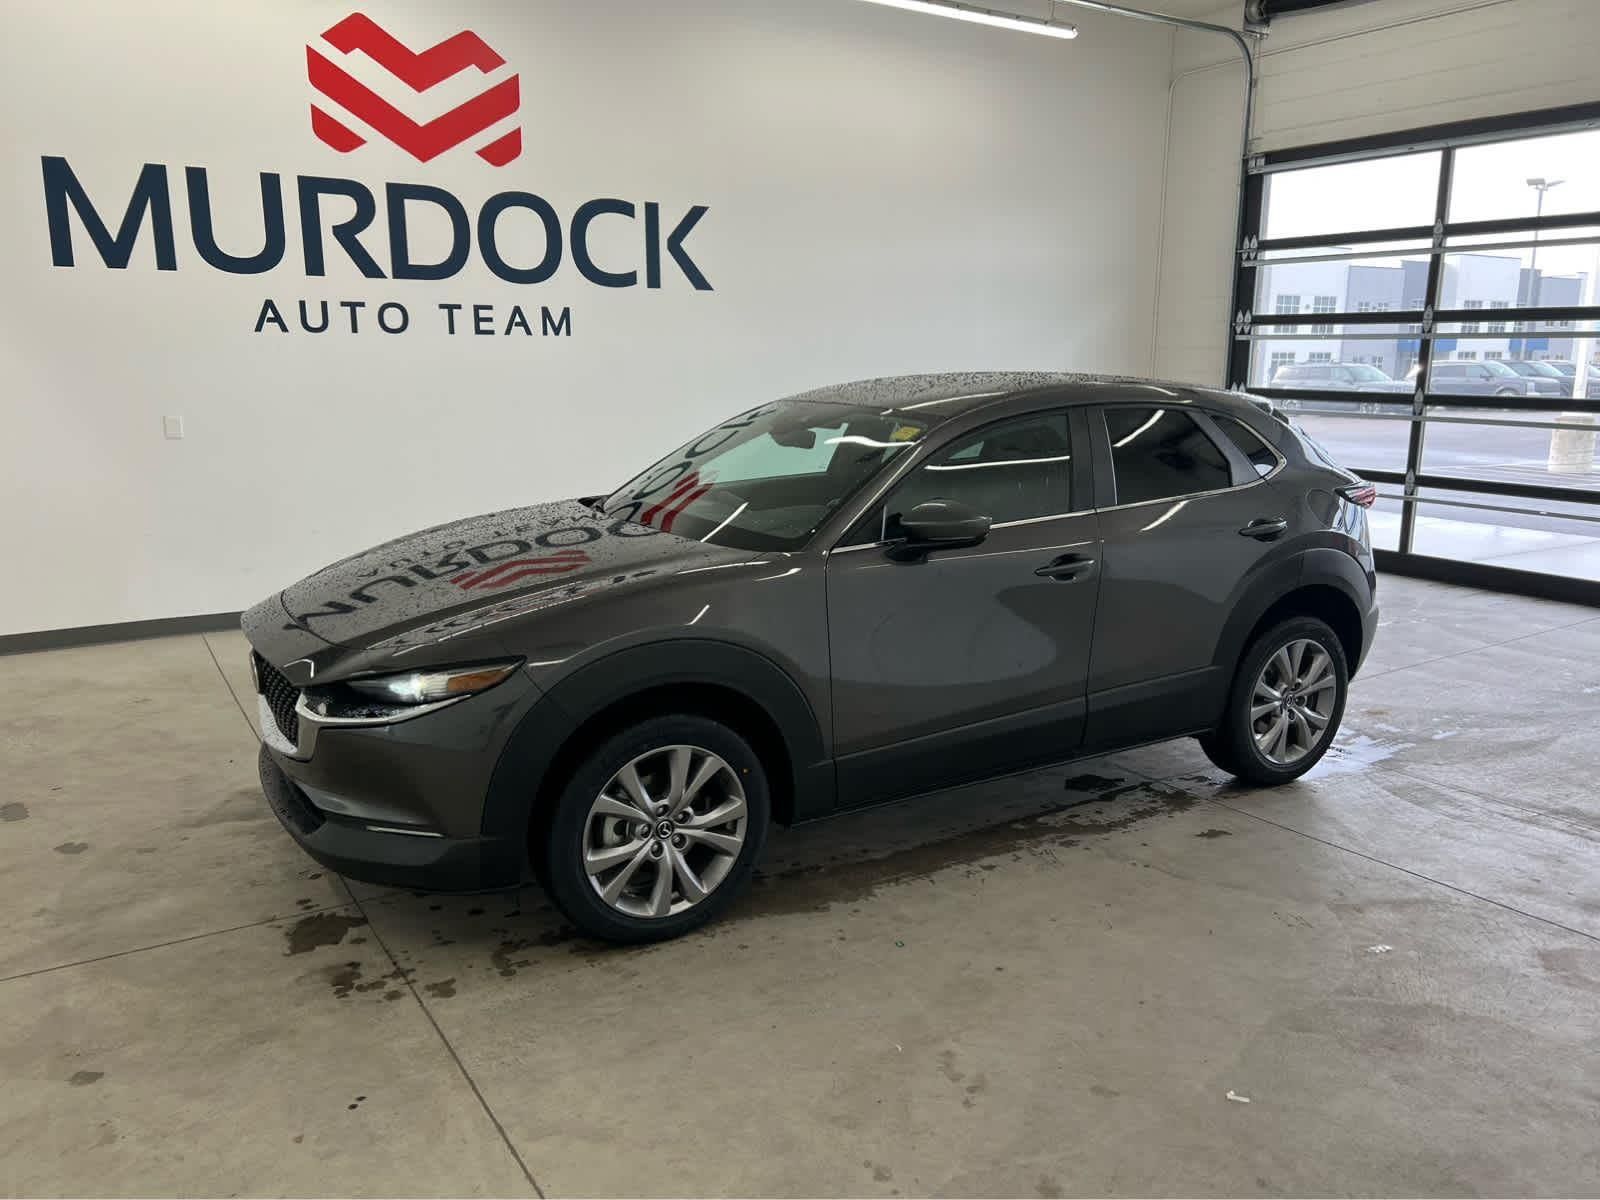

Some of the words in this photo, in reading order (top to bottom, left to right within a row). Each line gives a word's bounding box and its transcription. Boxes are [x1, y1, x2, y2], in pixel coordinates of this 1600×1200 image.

[41, 155, 714, 292] MURDOCK
[254, 298, 409, 335] AUTO
[439, 303, 572, 337] TEAM
